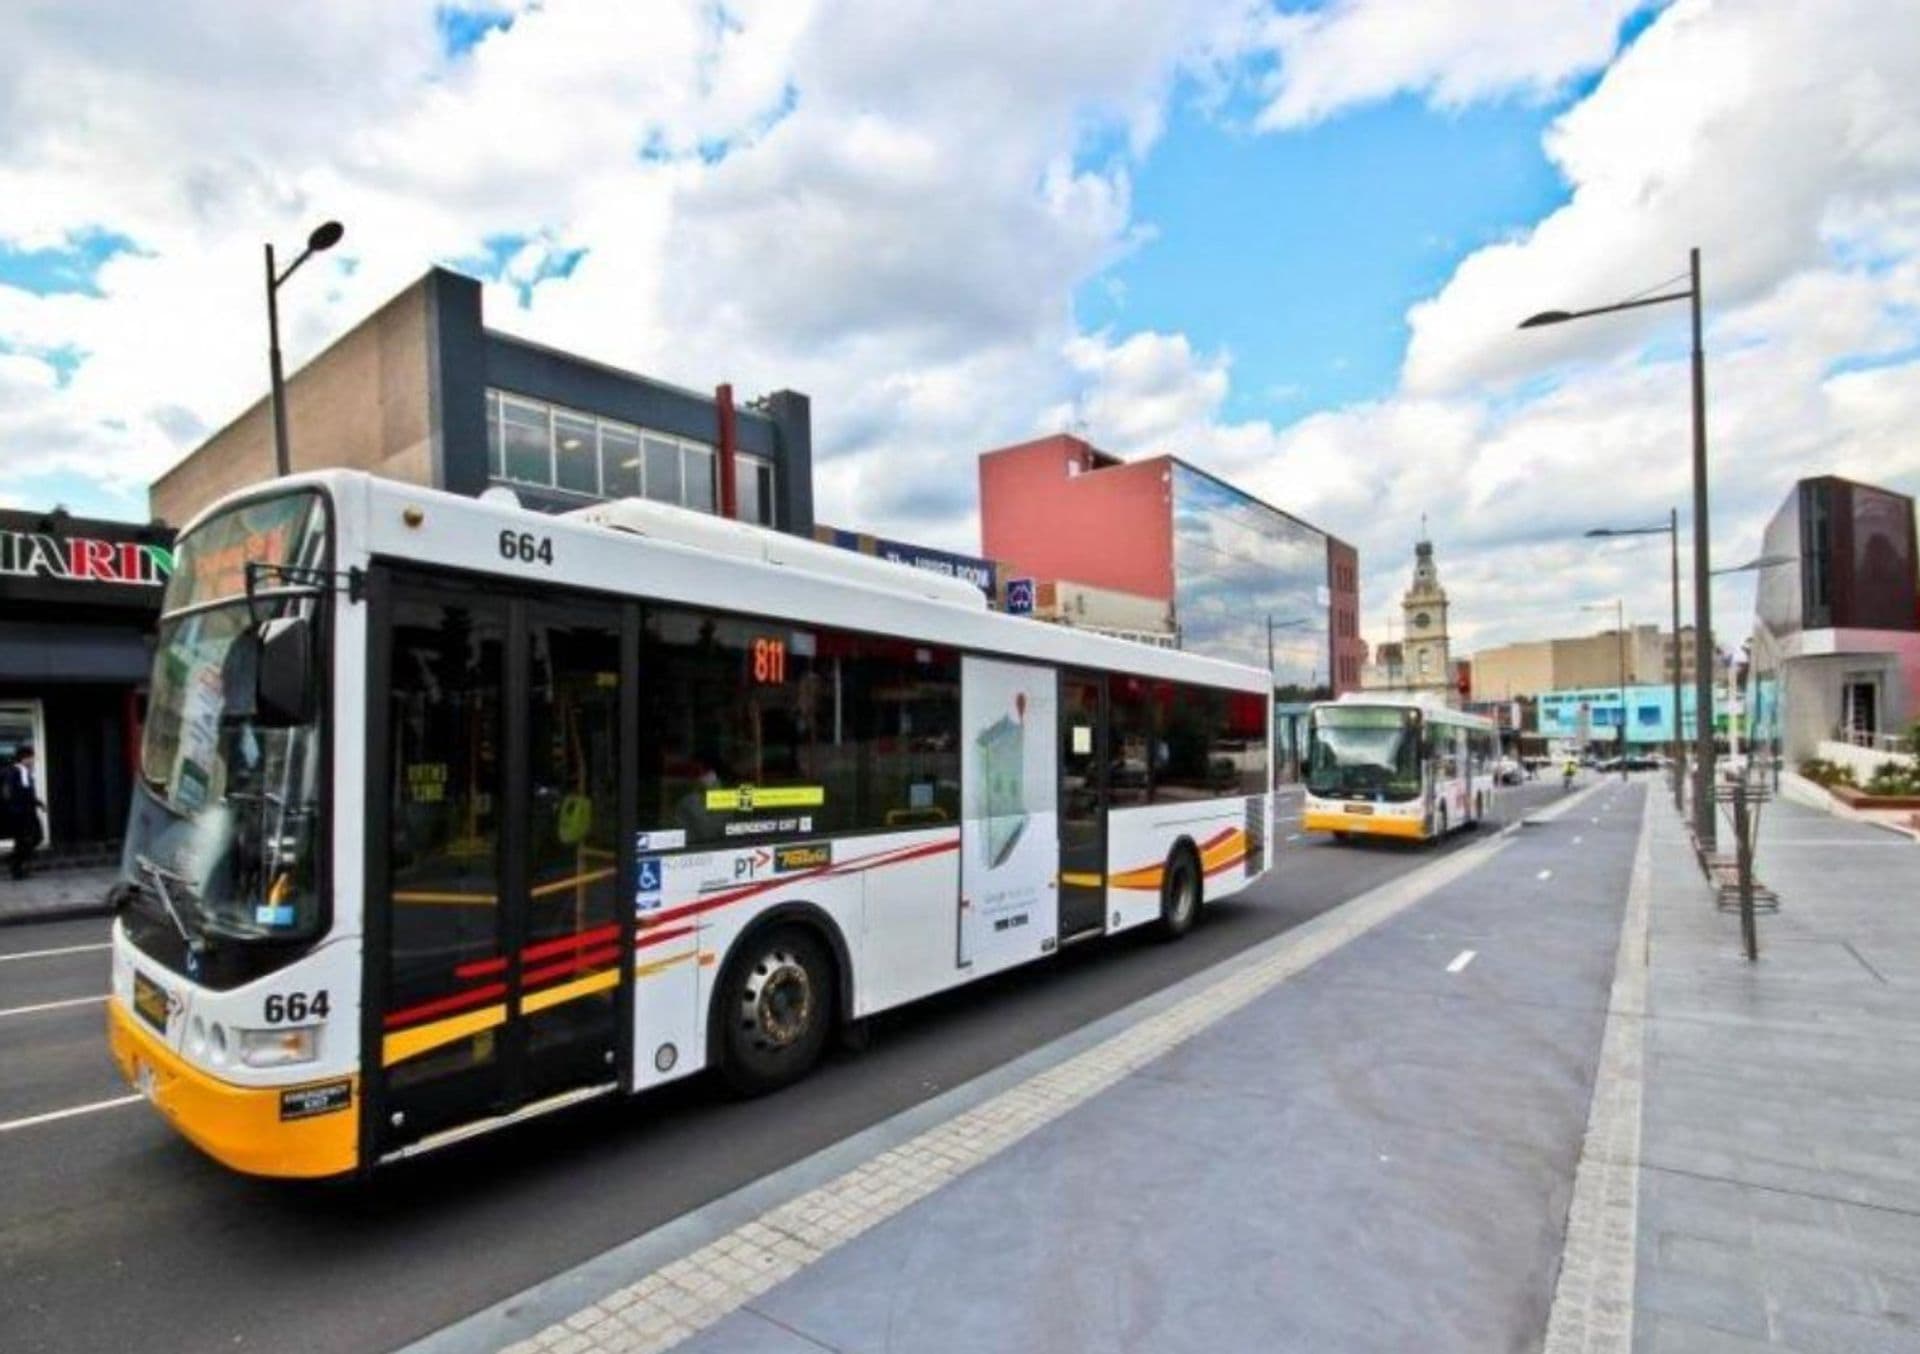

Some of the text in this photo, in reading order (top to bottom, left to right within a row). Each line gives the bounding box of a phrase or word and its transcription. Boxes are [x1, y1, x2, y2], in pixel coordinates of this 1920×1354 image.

[499, 529, 554, 566] 664
[754, 638, 784, 683] 811
[264, 989, 331, 1024] 664
